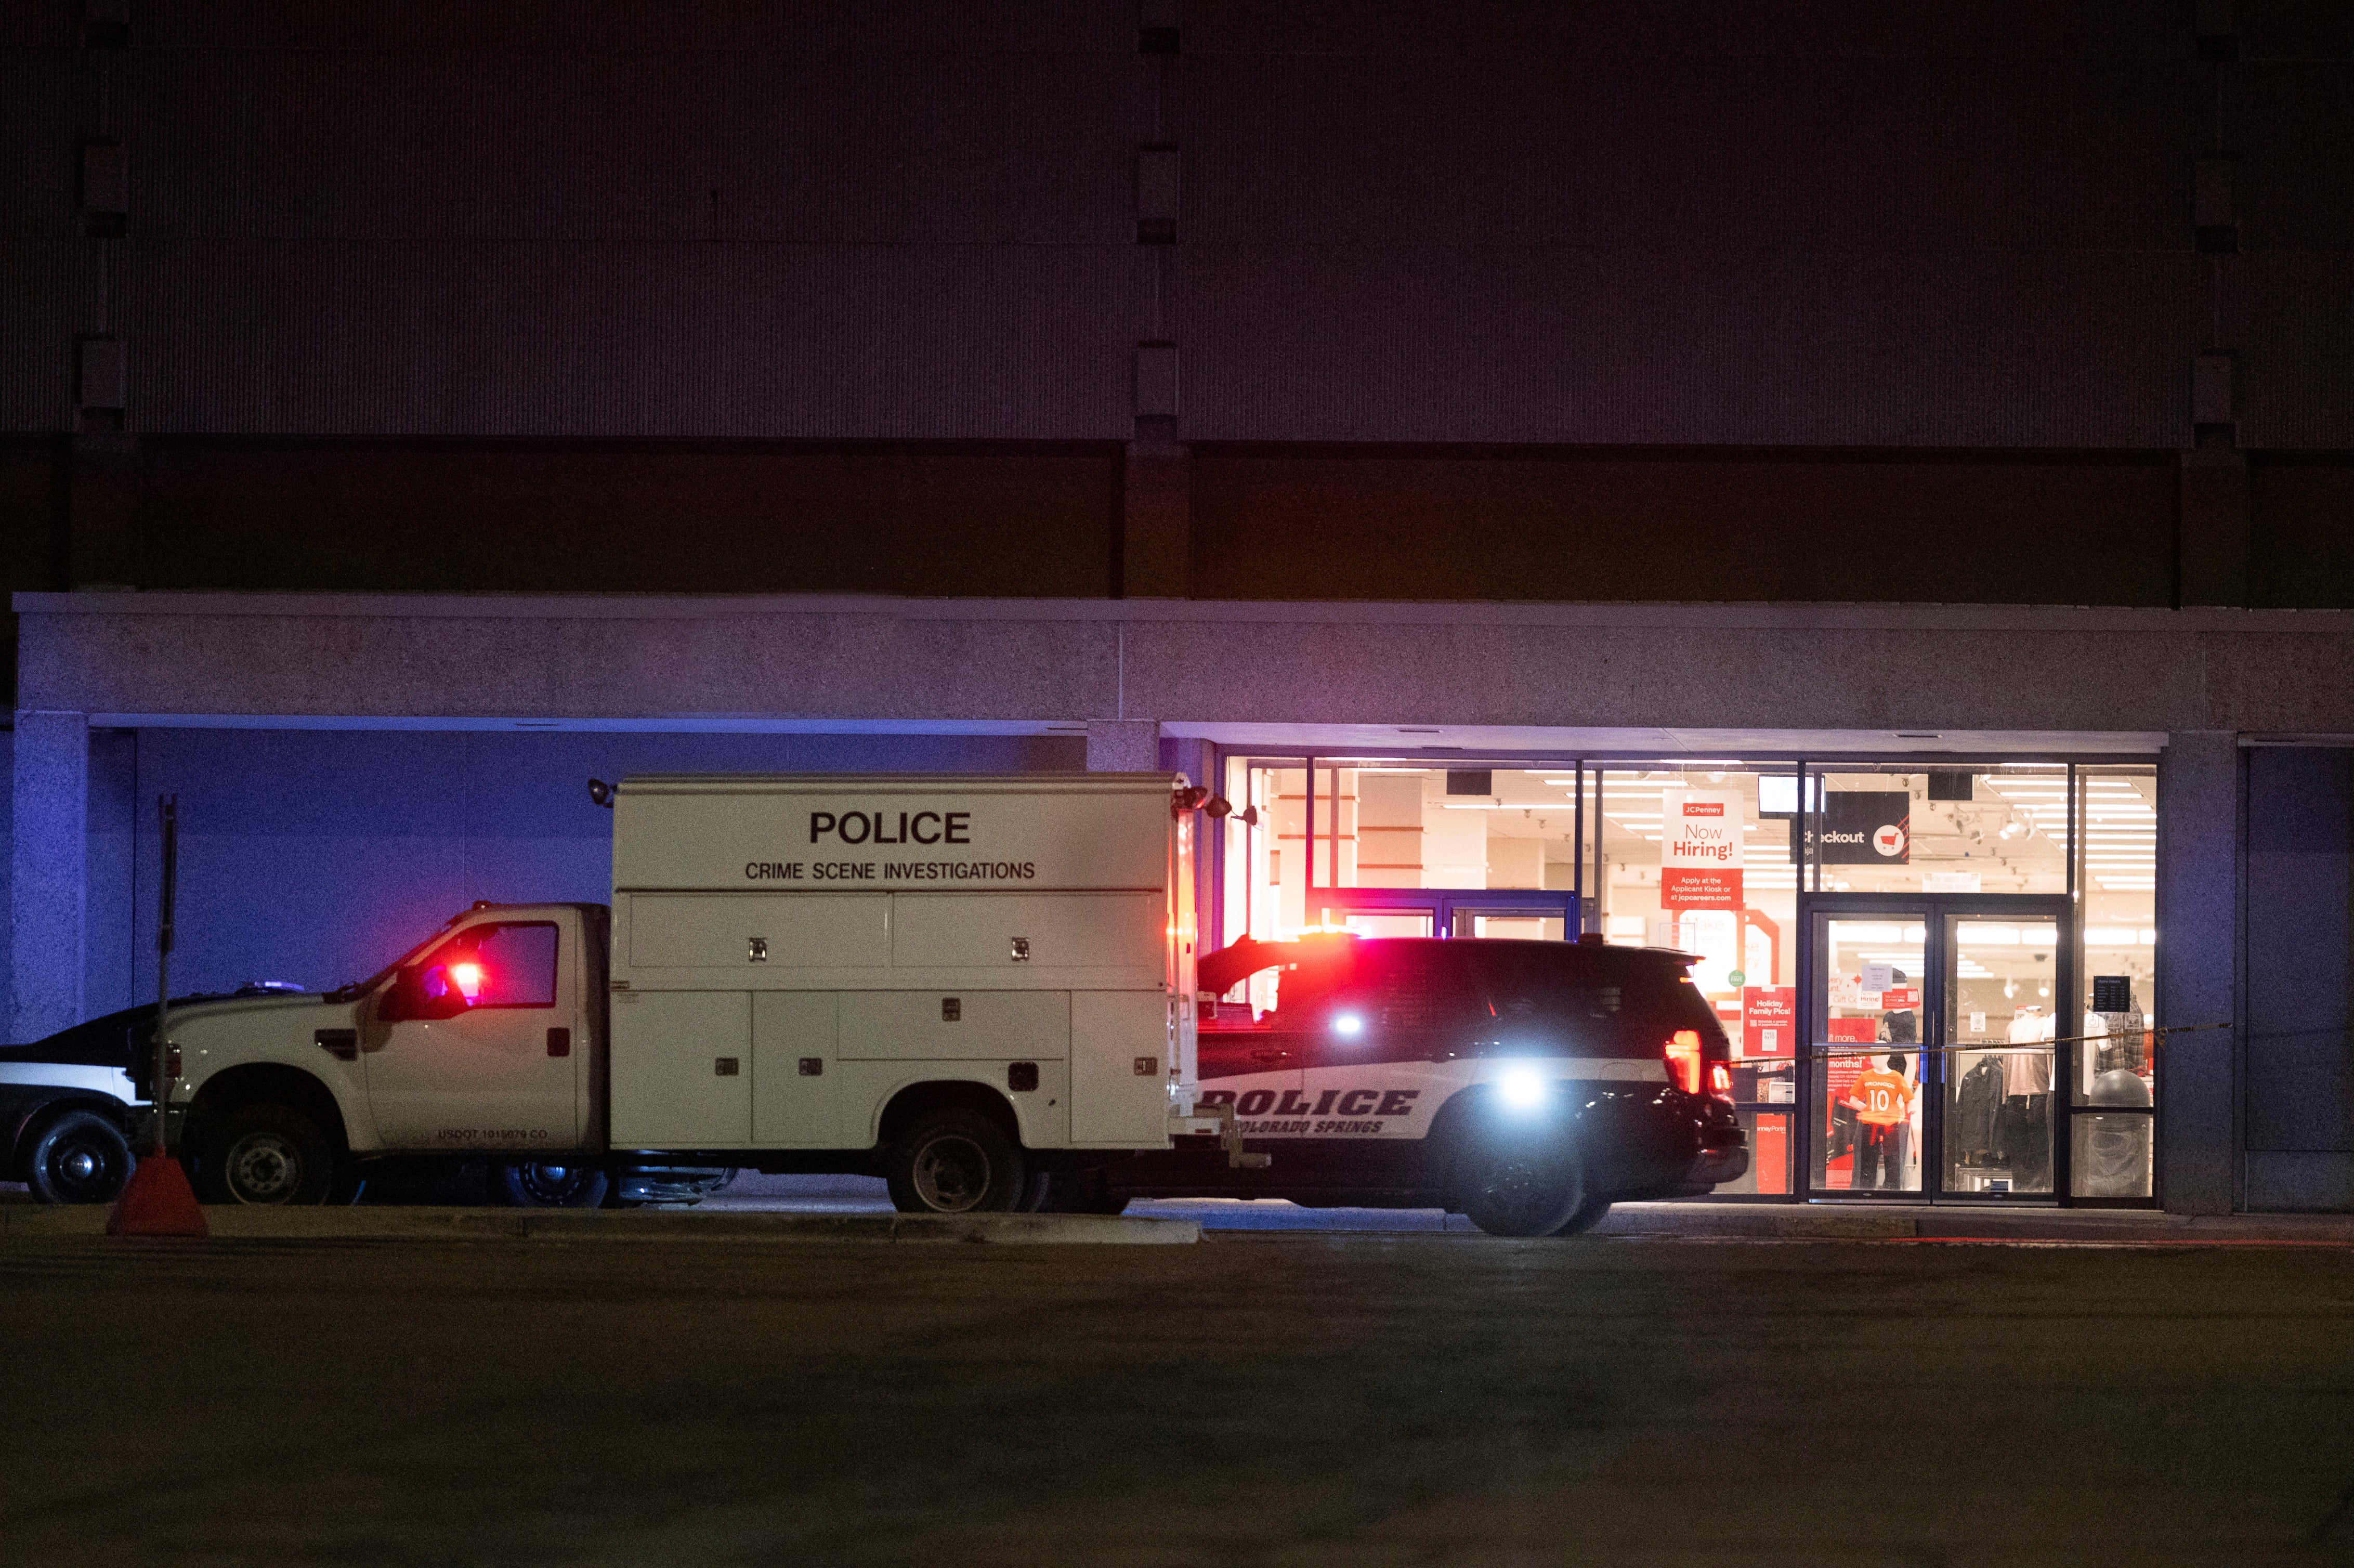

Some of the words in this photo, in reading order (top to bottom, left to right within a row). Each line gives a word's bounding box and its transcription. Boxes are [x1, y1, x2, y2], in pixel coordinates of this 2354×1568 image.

[810, 811, 971, 844] POLICE
[1685, 824, 1722, 839] Now
[1673, 841, 1733, 860] Hiring!
[746, 862, 803, 880] CRIME
[812, 862, 876, 880] SCENE
[884, 862, 1035, 880] INVESTIGATIONS
[1756, 1000, 1783, 1009] Holiday
[1829, 1060, 1863, 1068] months!
[1864, 1081, 1895, 1089] BRONCOS
[1200, 1090, 1421, 1116] POLICE
[1869, 1089, 1890, 1112] 10
[1241, 1120, 1311, 1133] OLORADO
[1314, 1121, 1383, 1133] SPRINGS
[438, 1130, 478, 1139] USDOT
[530, 1130, 548, 1139] CO
